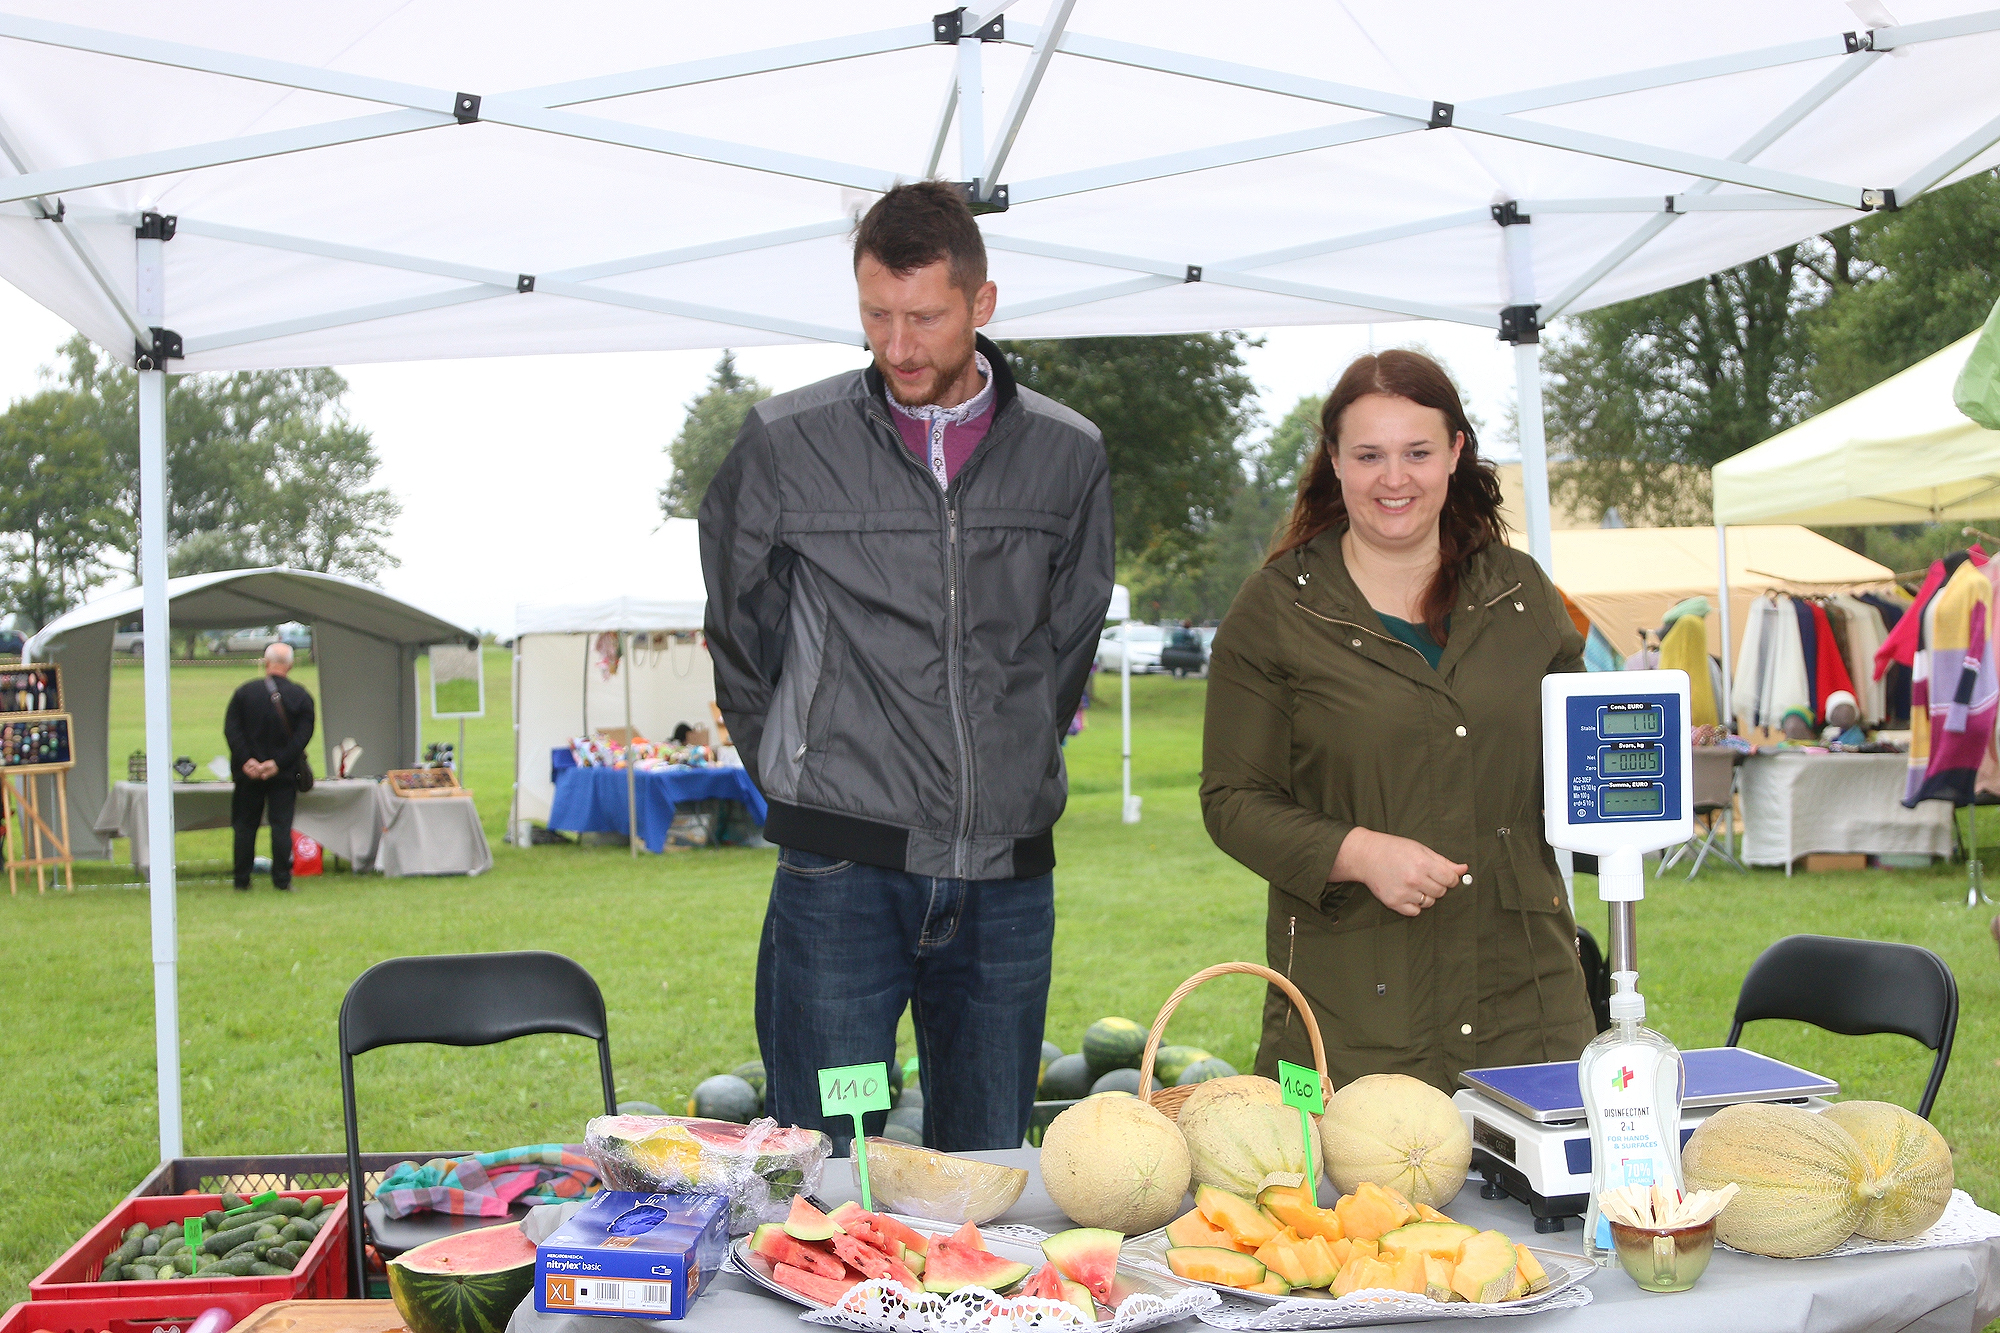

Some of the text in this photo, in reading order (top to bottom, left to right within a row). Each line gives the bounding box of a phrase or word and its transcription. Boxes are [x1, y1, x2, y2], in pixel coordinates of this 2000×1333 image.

[1633, 713, 1656, 731] 1.10
[827, 1078, 878, 1100] 1.10
[1284, 1076, 1314, 1098] 1.60
[1604, 1107, 1649, 1117] DISINFECTANT
[1621, 1140, 1658, 1149] SURFACES
[1626, 1162, 1651, 1177] 70%
[582, 1261, 602, 1271] basic
[550, 1283, 573, 1301] XL
